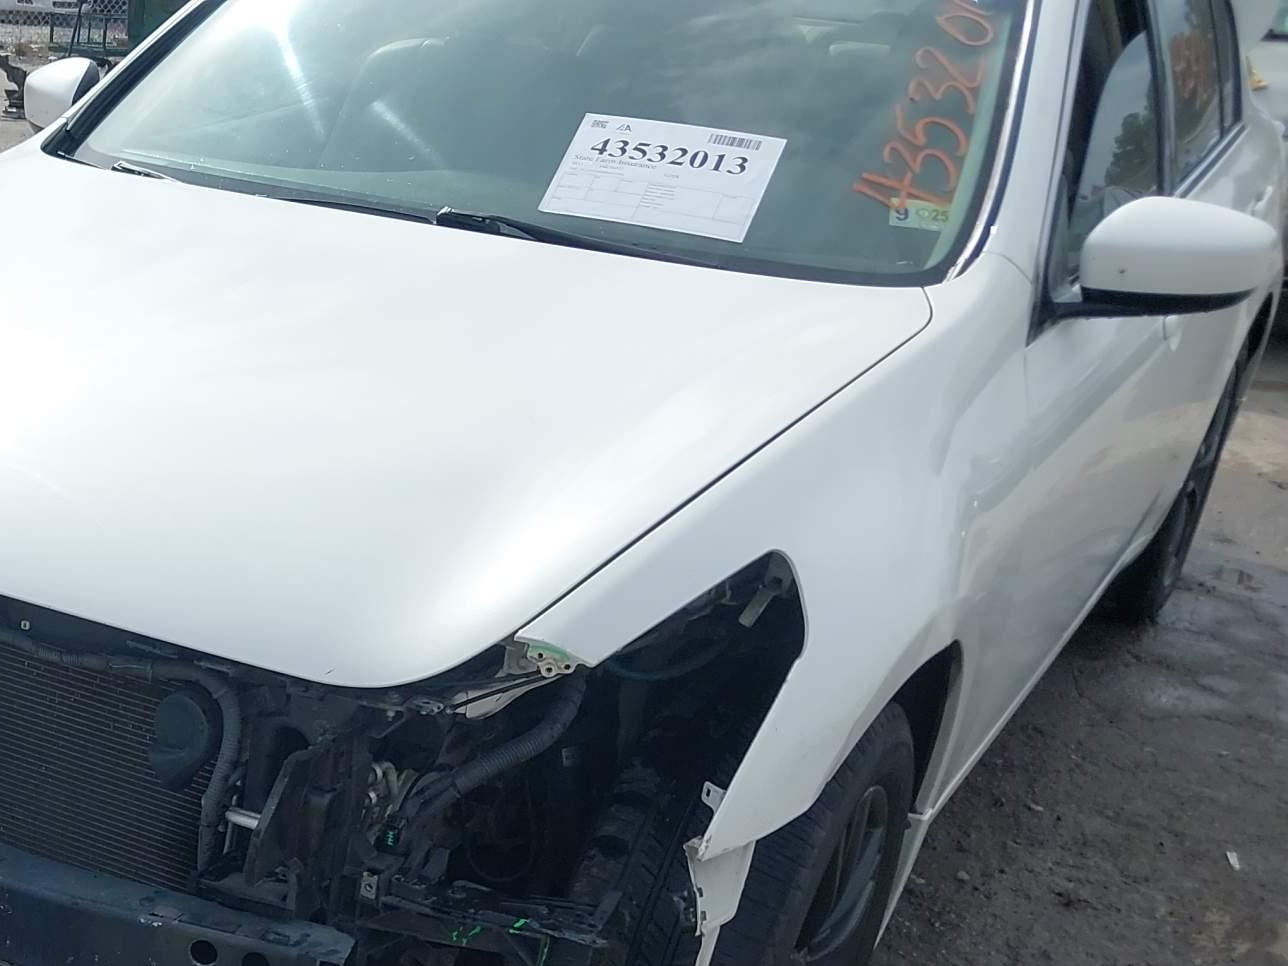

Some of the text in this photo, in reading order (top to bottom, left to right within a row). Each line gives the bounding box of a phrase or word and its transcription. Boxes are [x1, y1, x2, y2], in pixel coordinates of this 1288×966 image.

[590, 138, 749, 176] 43532013
[595, 156, 617, 165] Farm
[619, 159, 657, 169] Insurance
